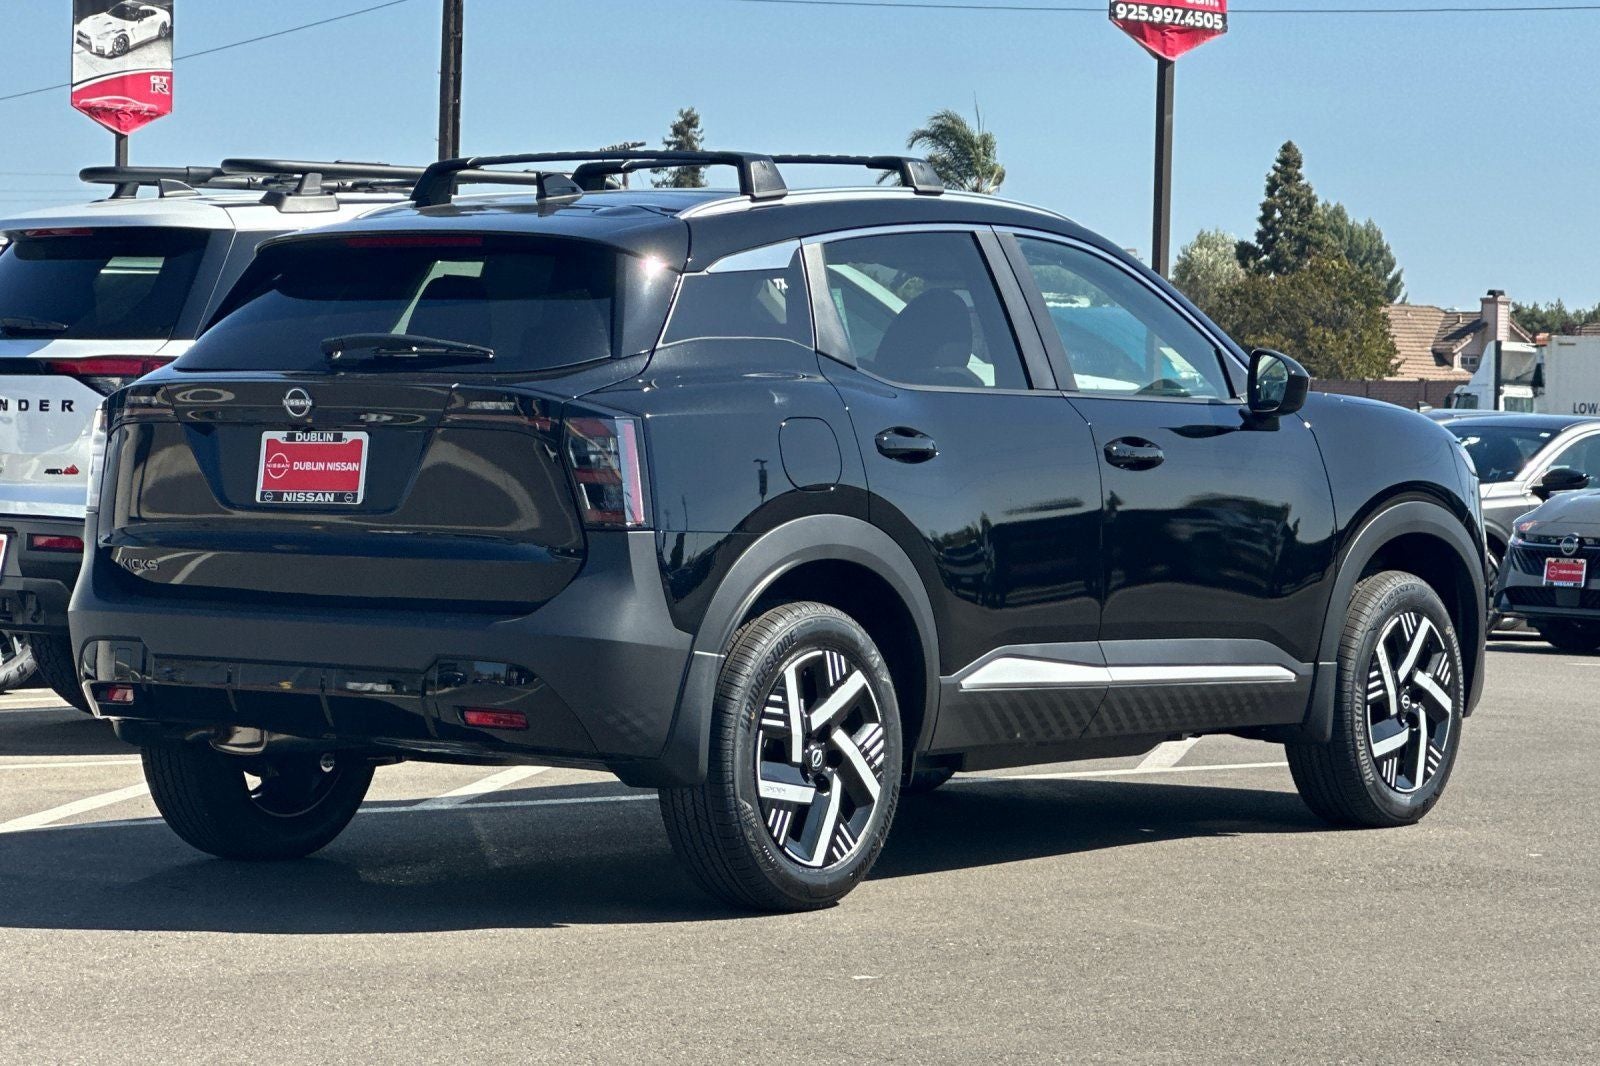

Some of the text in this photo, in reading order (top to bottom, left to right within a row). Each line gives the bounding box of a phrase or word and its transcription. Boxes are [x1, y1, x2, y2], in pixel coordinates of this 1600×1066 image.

[1115, 4, 1223, 28] 925.997.4505
[295, 432, 334, 442] DUBLIN
[293, 461, 359, 471] DUBLIN NISSAN
[282, 492, 335, 502] NISSAN
[121, 558, 159, 571] KICKS
